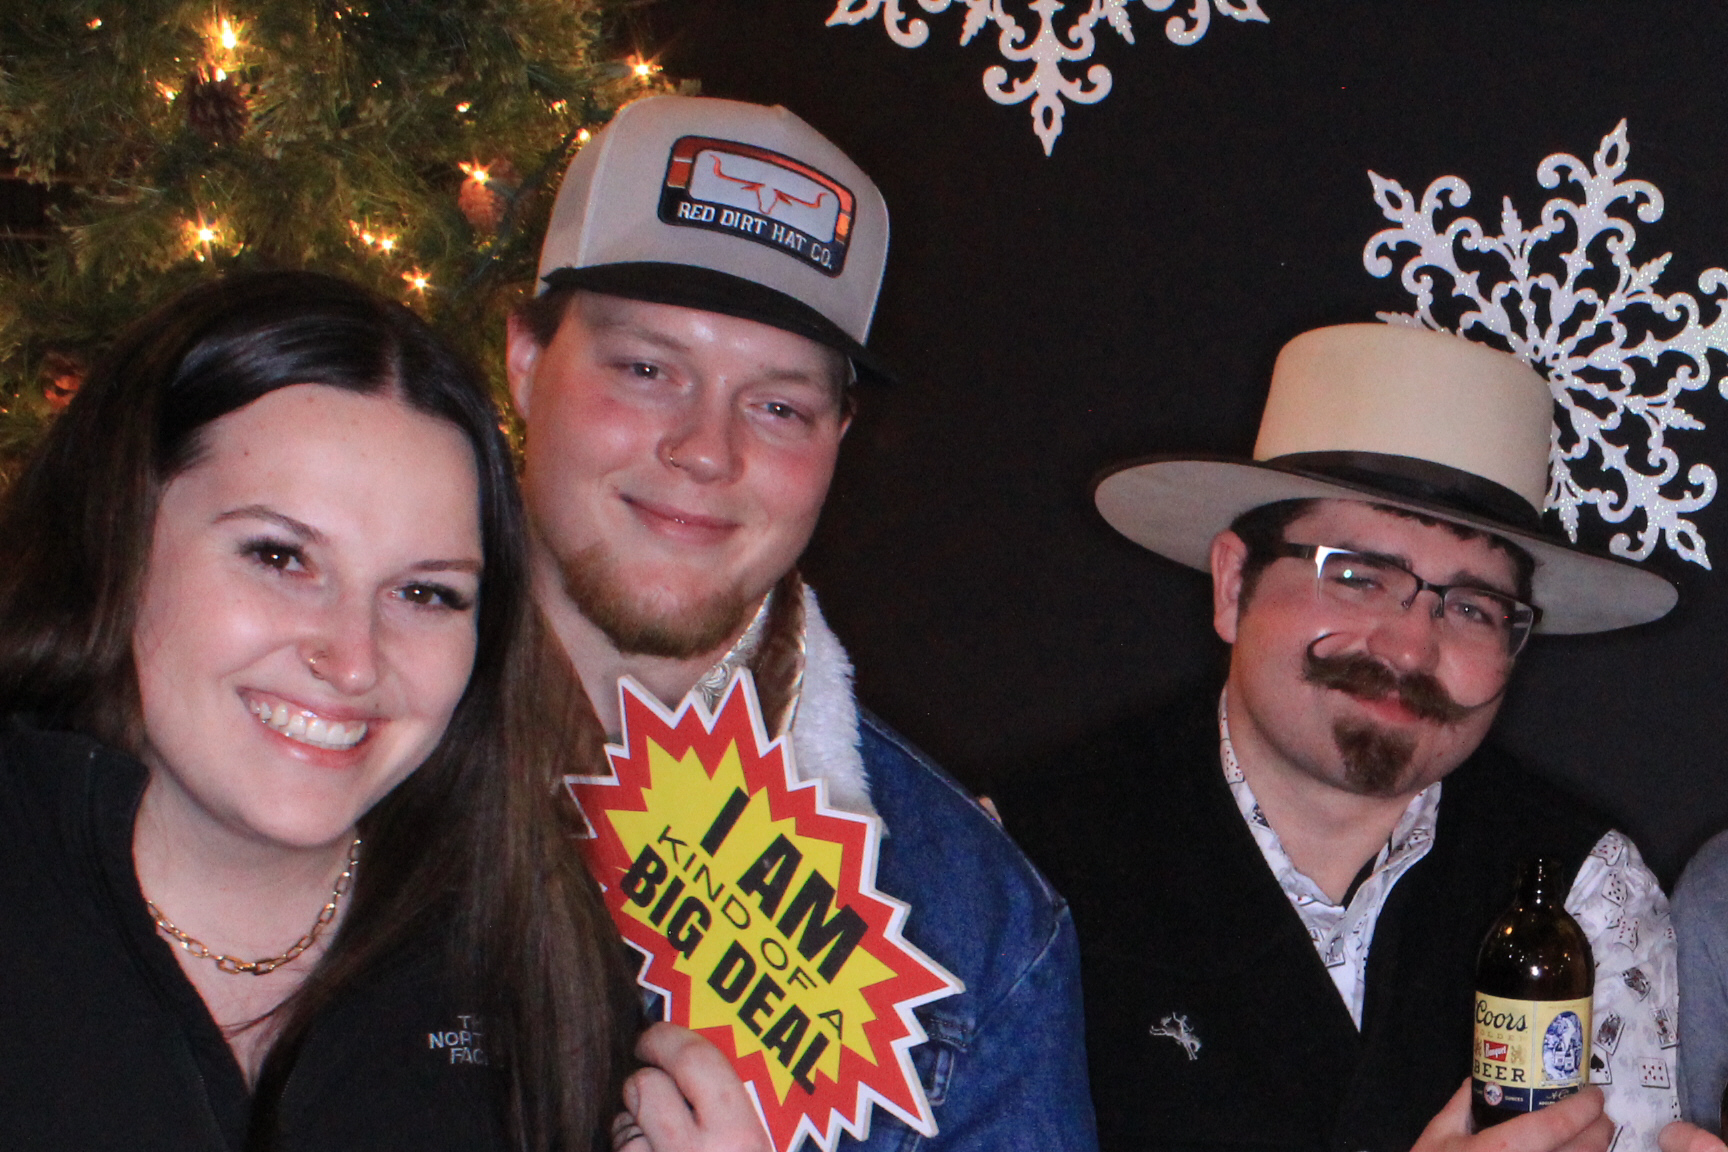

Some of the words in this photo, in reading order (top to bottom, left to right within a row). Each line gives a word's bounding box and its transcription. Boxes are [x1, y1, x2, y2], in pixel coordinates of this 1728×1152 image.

[677, 201, 716, 223] RED
[719, 209, 768, 235] DIRT
[771, 223, 807, 252] HAT
[810, 243, 832, 270] CO.
[700, 786, 750, 857] I
[736, 833, 869, 984] AM
[658, 825, 751, 930] KIND
[761, 937, 818, 991] OF
[818, 1008, 843, 1040] A
[619, 843, 712, 961] BIG
[707, 939, 830, 1096] DEAL
[1475, 999, 1528, 1033] Coors
[450, 1046, 489, 1064] FAC
[1473, 1058, 1526, 1083] BEER
